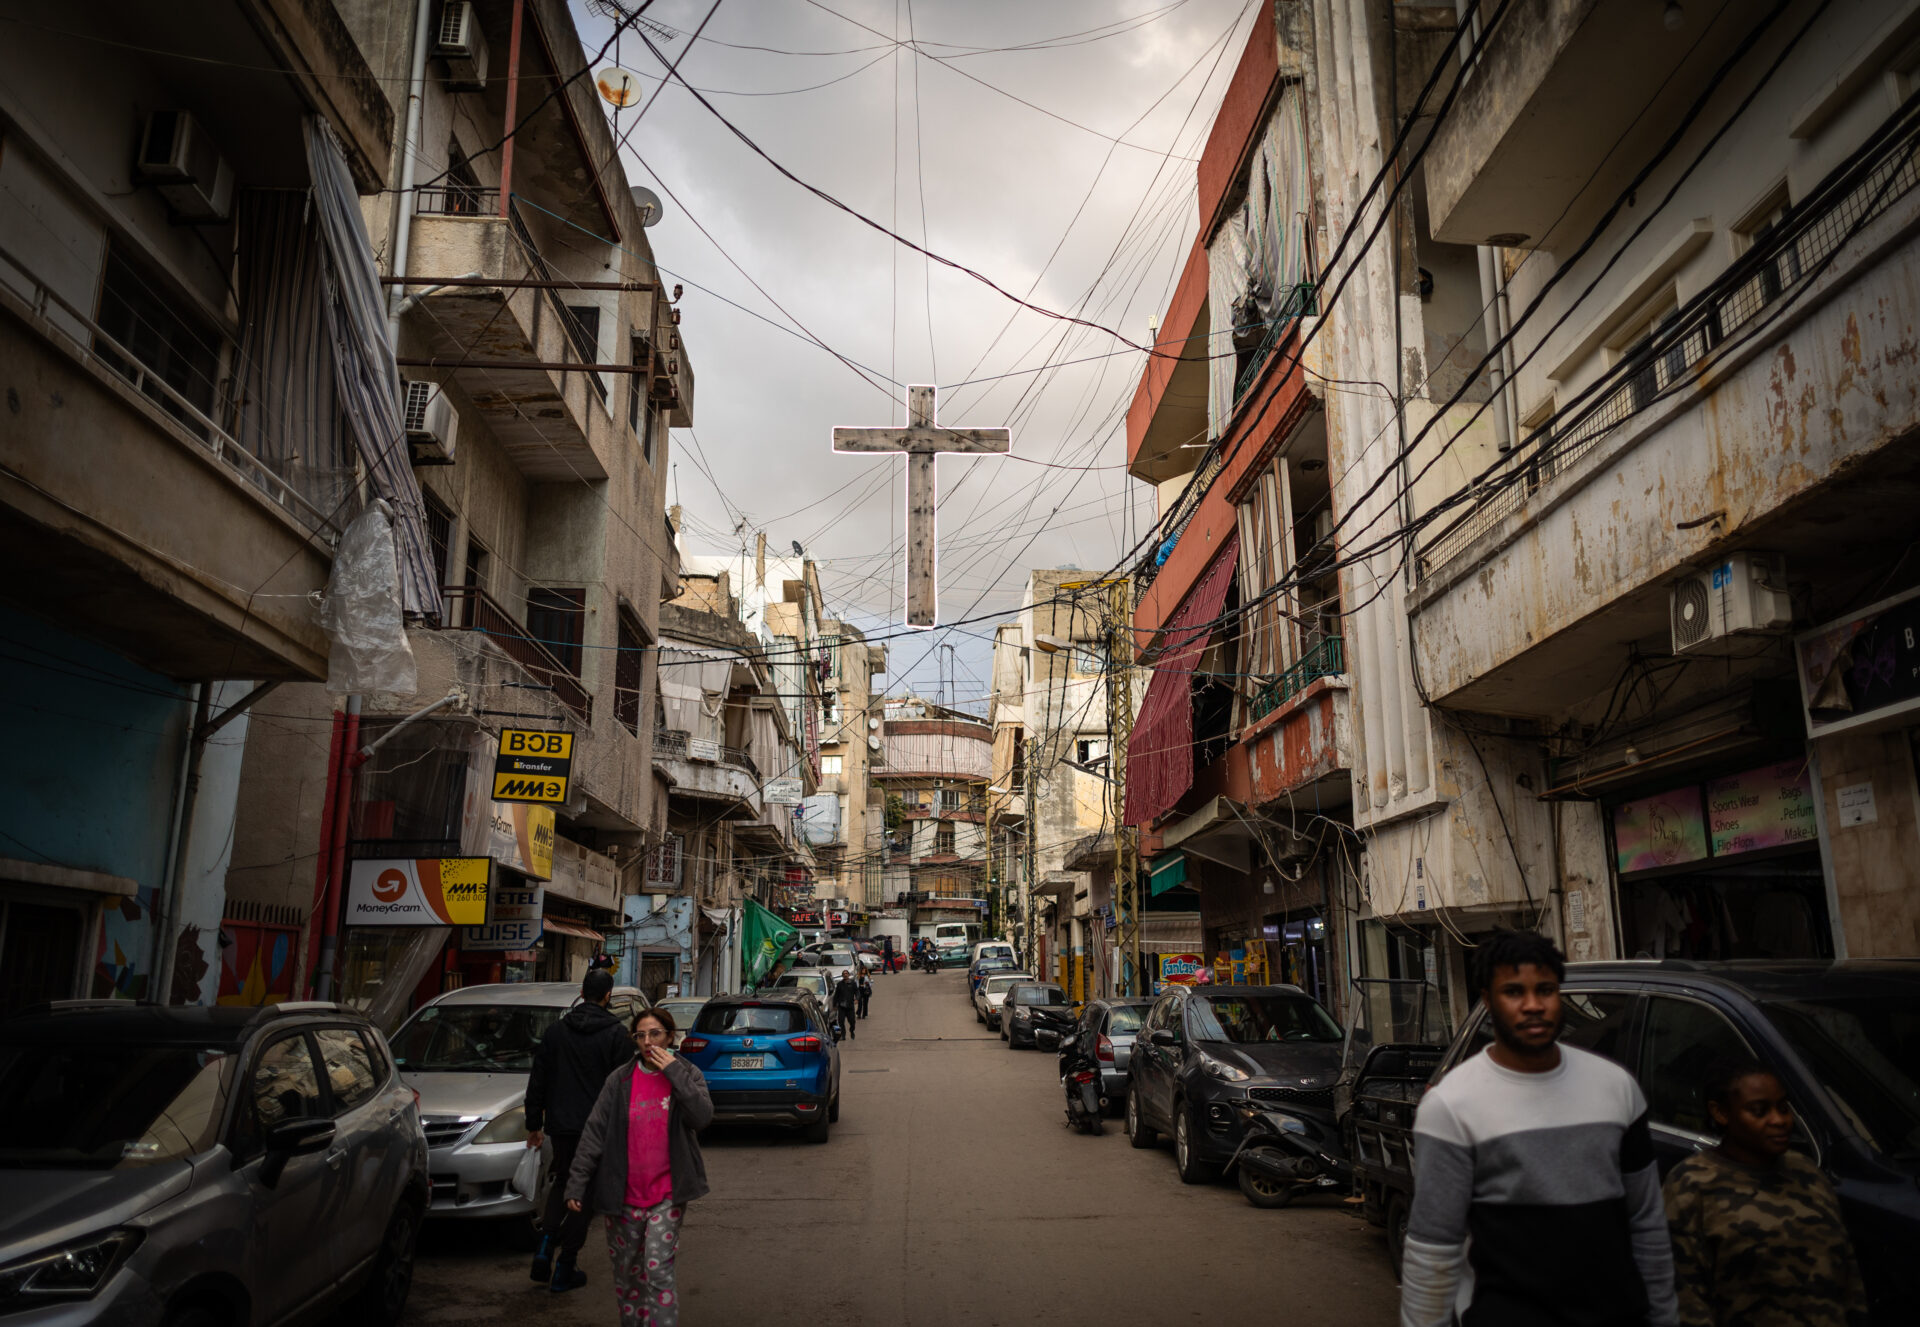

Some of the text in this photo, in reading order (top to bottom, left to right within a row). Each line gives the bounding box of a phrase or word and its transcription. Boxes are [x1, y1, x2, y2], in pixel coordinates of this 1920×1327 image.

[514, 758, 552, 771] iTransfer
[1781, 786, 1802, 801] Bags
[1712, 794, 1760, 815] Sports Wear
[1715, 819, 1740, 833] Shoes
[1717, 836, 1755, 853] Flip-Flops
[356, 903, 421, 914] MoneyGram
[468, 923, 532, 941] WISE
